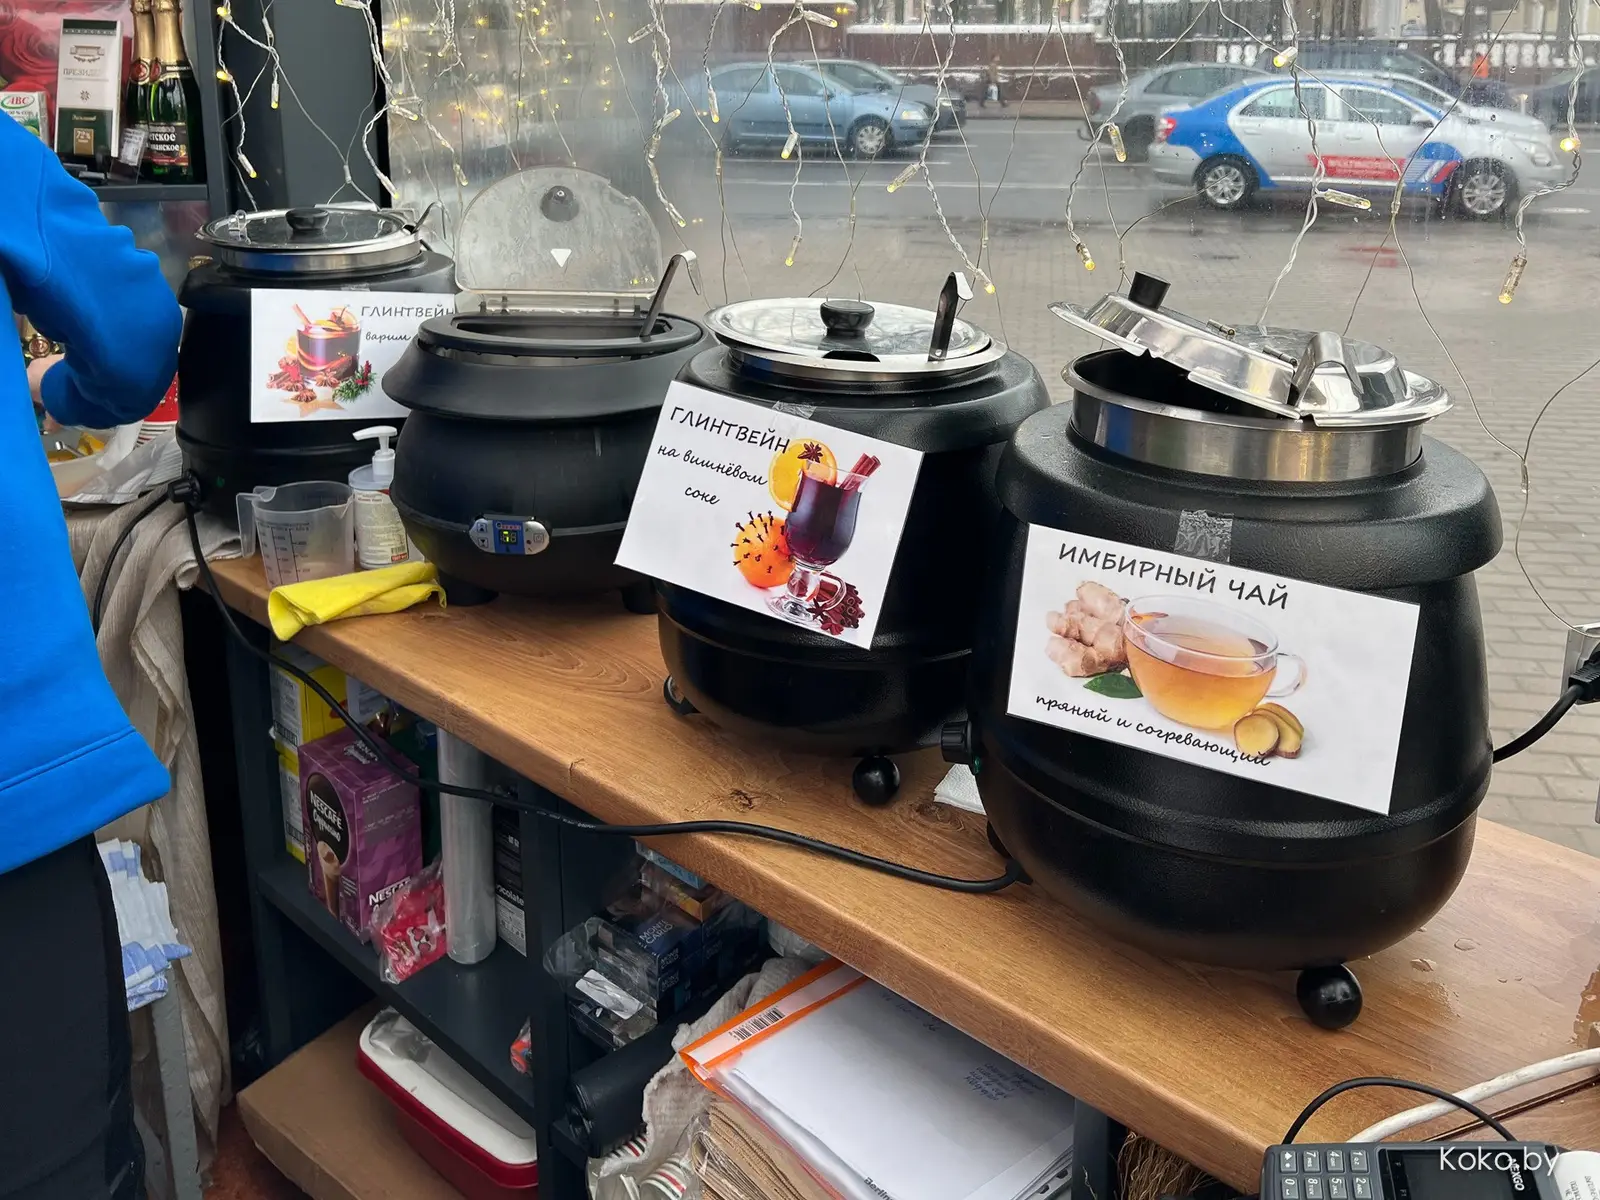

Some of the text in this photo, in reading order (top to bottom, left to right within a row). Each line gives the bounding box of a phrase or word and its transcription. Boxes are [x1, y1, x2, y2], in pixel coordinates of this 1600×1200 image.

[365, 332, 411, 343] варим
[670, 406, 790, 454] ГЛИНТВЕЙН
[657, 445, 768, 486] на вишнёвом
[684, 486, 720, 505] соке
[1058, 543, 1288, 609] ИМБИРНЫЙ ЧАЙ
[1036, 695, 1271, 766] пряный и согревающий
[864, 1177, 896, 1200] Berlin
